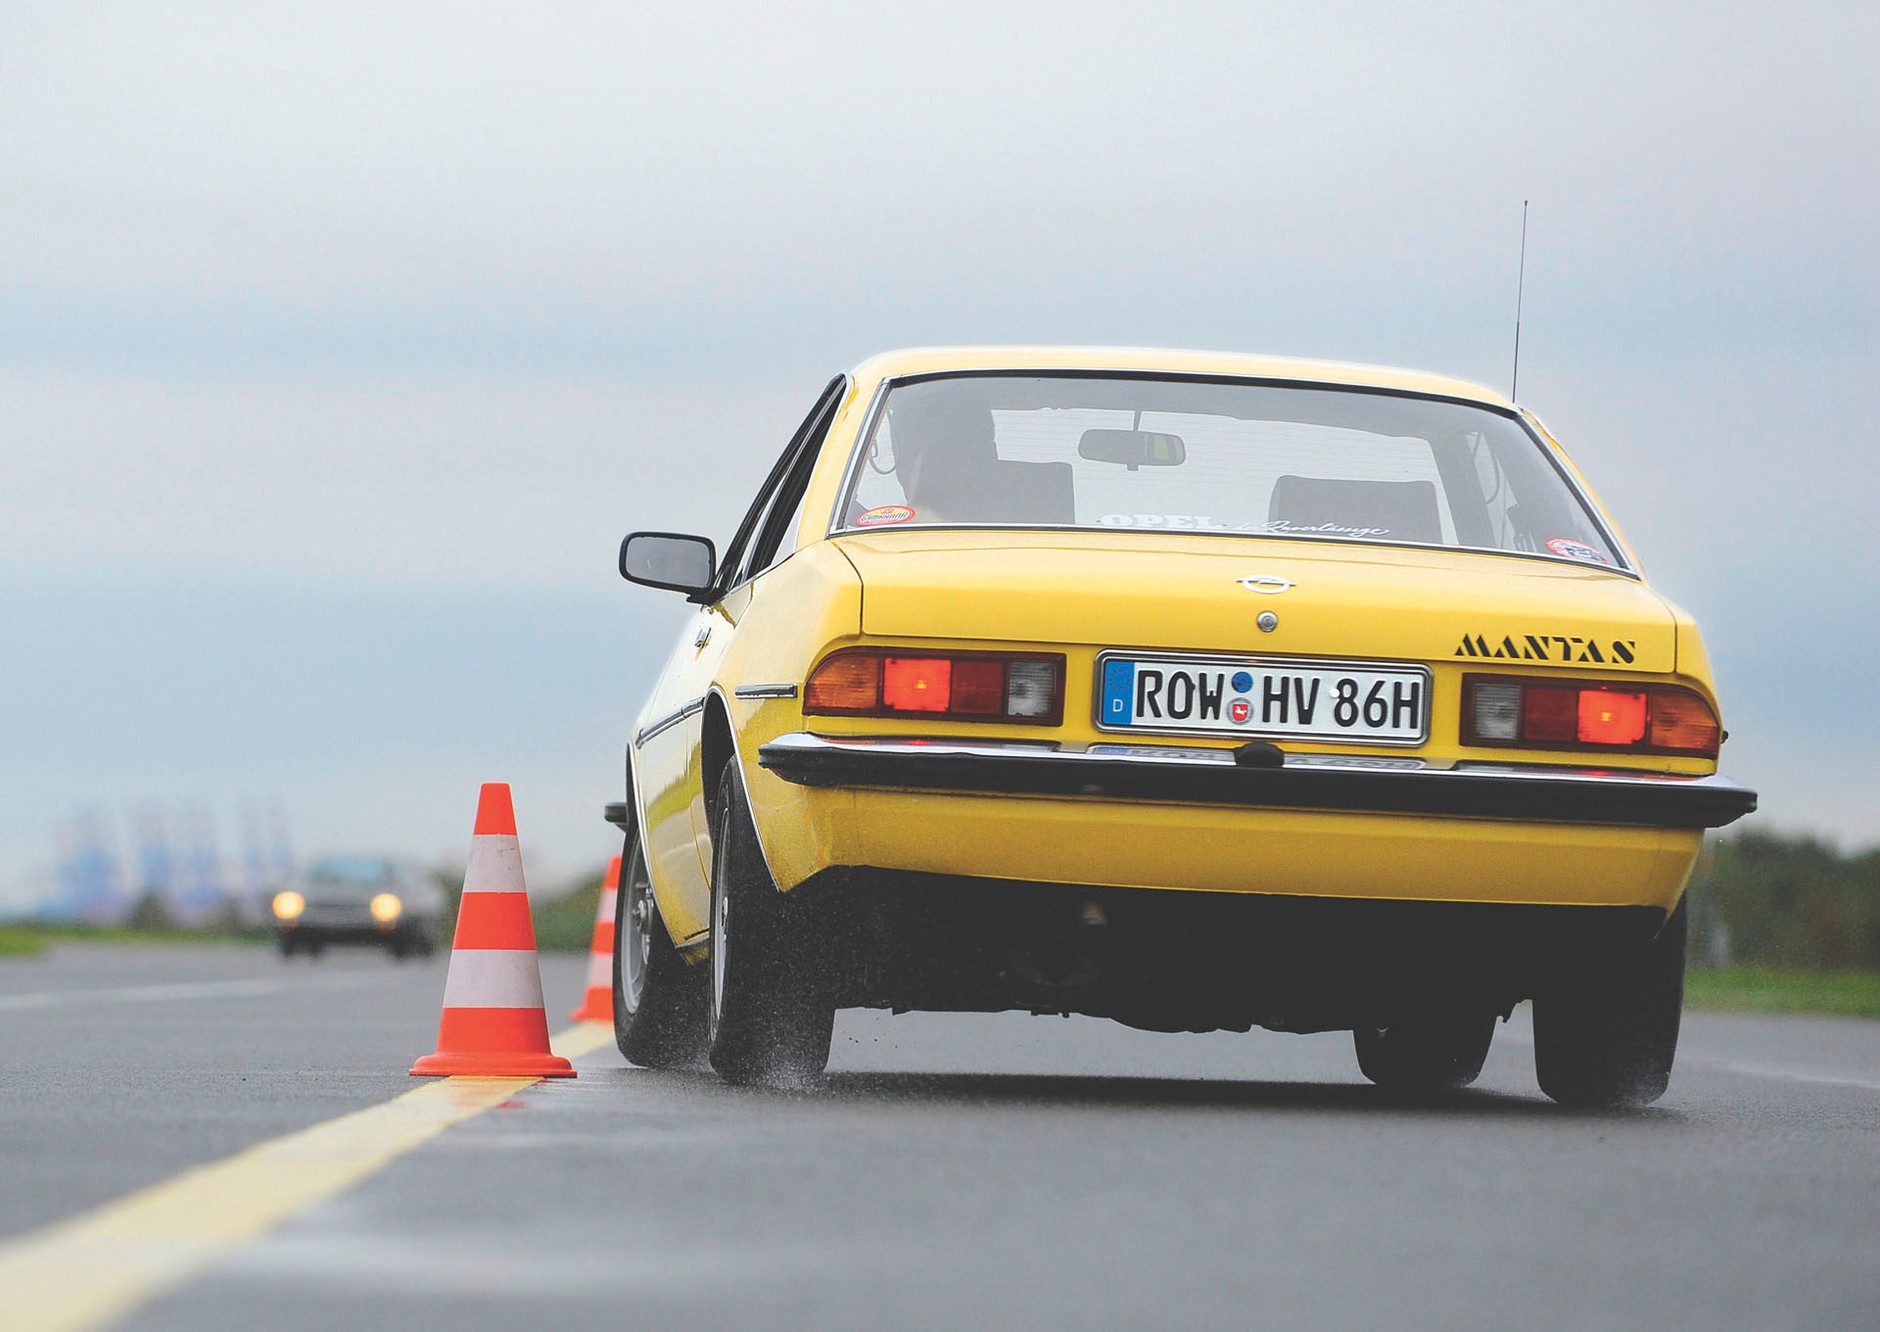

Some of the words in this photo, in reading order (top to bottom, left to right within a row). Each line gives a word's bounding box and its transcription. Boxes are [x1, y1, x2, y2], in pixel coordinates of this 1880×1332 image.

[1100, 514, 1223, 529] OPEL
[1454, 633, 1635, 664] MANTAS
[1112, 699, 1123, 712] D
[1136, 669, 1224, 720] ROW
[1262, 675, 1320, 725] HV
[1334, 678, 1420, 729] 86H
